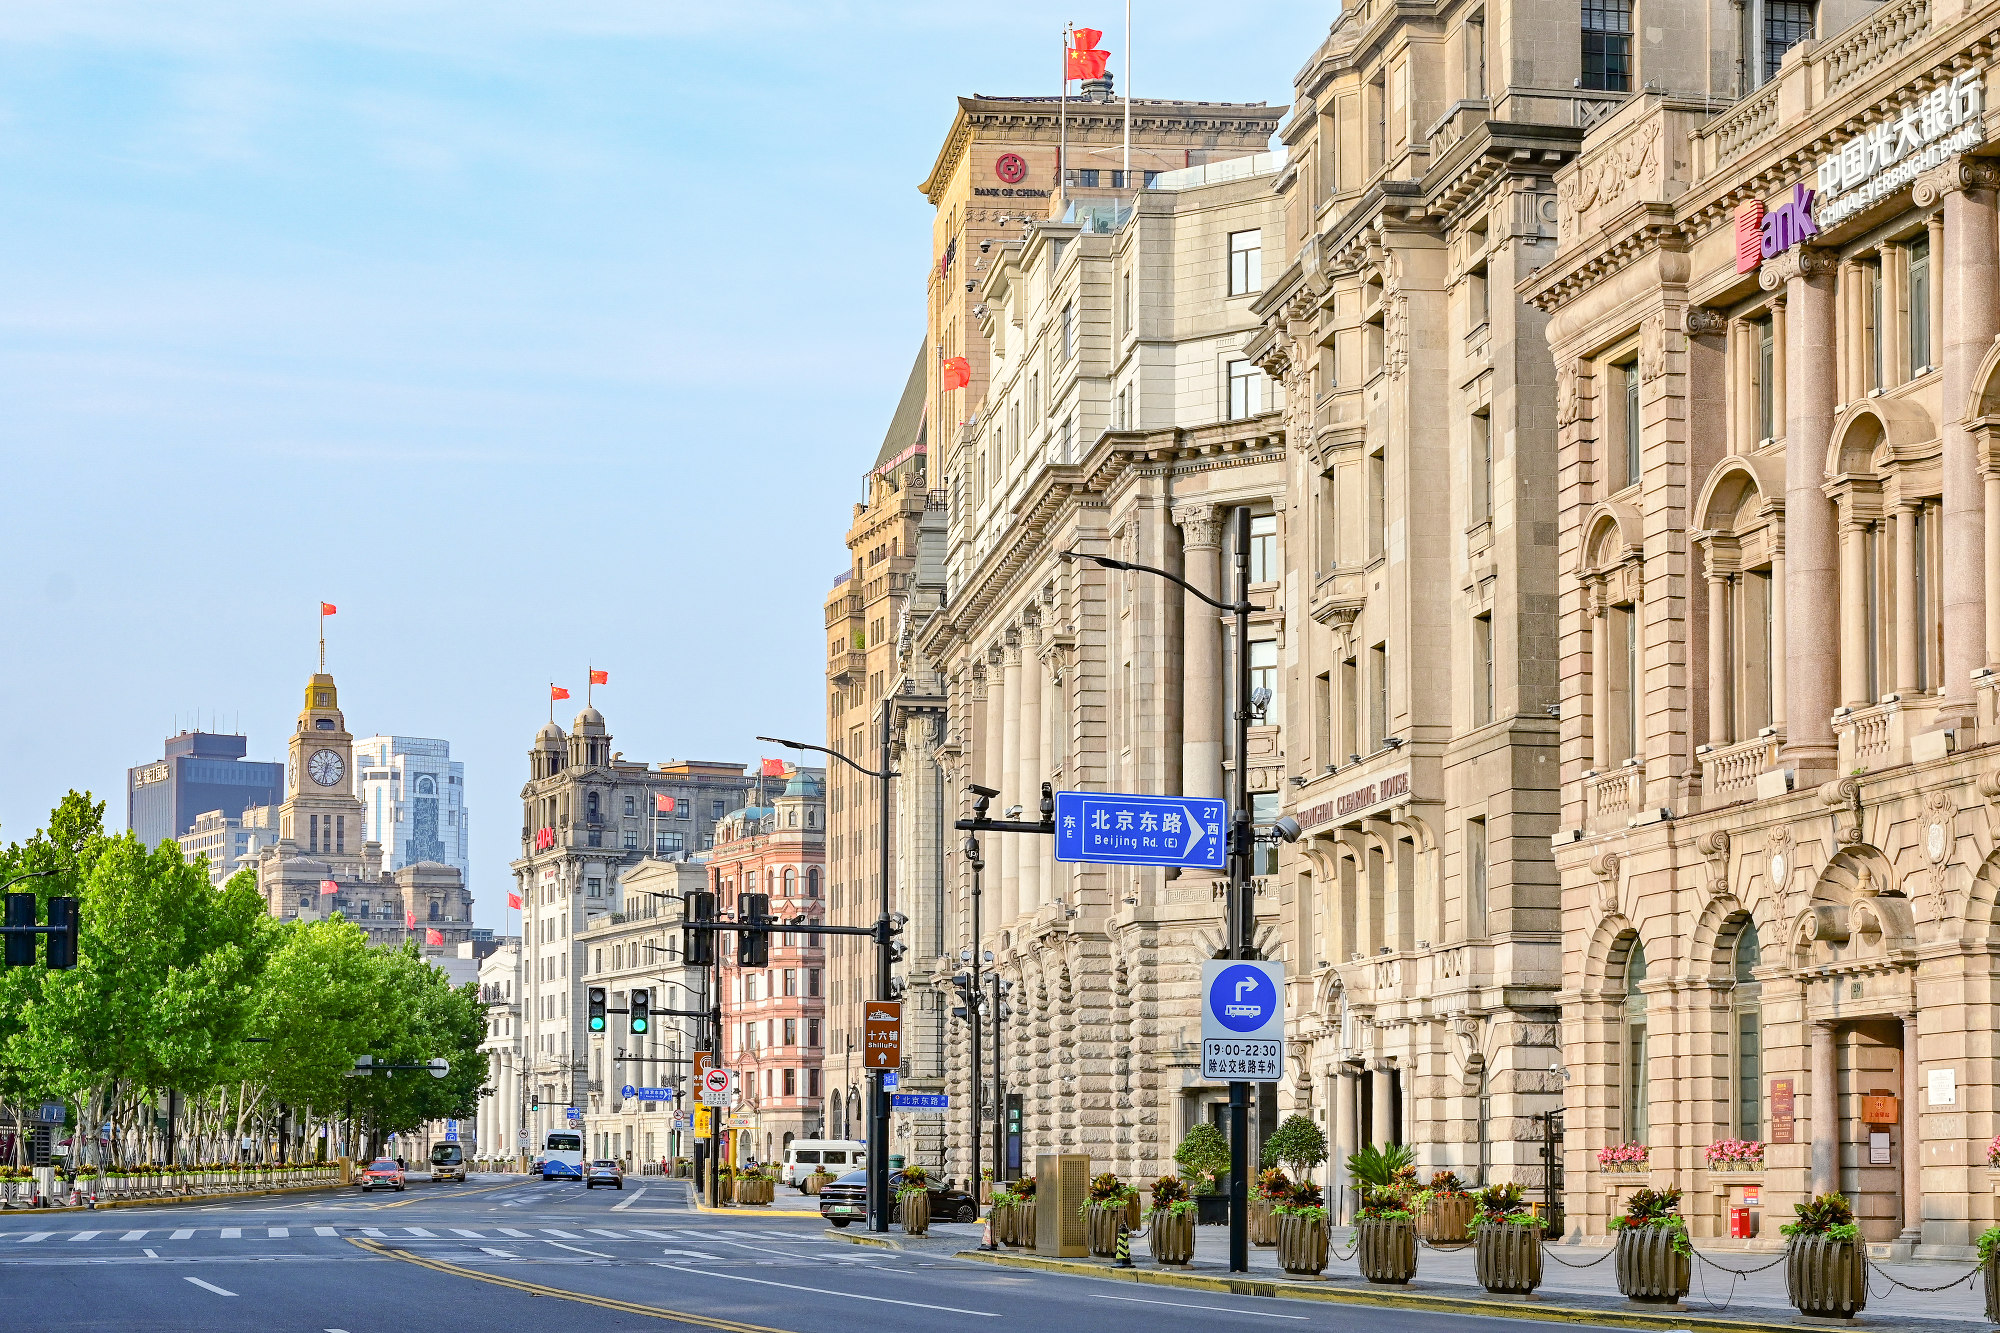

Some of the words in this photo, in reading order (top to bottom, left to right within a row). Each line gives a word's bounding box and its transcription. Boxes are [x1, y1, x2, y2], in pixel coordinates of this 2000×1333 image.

[1818, 67, 1982, 198] 中国光大银行
[1819, 191, 1862, 227] CHINA
[1858, 147, 1943, 205] EVERBRIGHT
[1940, 121, 1983, 160] BANK
[974, 188, 1000, 197] BANK
[1001, 188, 1014, 197] OF
[1015, 189, 1048, 198] CHINA
[1336, 783, 1377, 816] CLEARING
[1379, 771, 1409, 801] HOUSE
[1203, 807, 1218, 819] 27
[1062, 815, 1076, 829] 东
[1090, 809, 1183, 834] 北京东路
[1066, 830, 1073, 839] E
[1206, 822, 1220, 836] 西
[536, 826, 554, 850] AIA
[1094, 834, 1138, 849] Beijing
[1142, 837, 1159, 848] Rd.
[1164, 838, 1178, 848] (E)
[1208, 837, 1217, 845] W
[1206, 847, 1215, 860] 2
[867, 1029, 899, 1041] 十六铺
[1208, 1043, 1277, 1057] 19:00-22:30
[1208, 1058, 1276, 1075] 除公交线路车外
[902, 1095, 939, 1106] 北京东路
